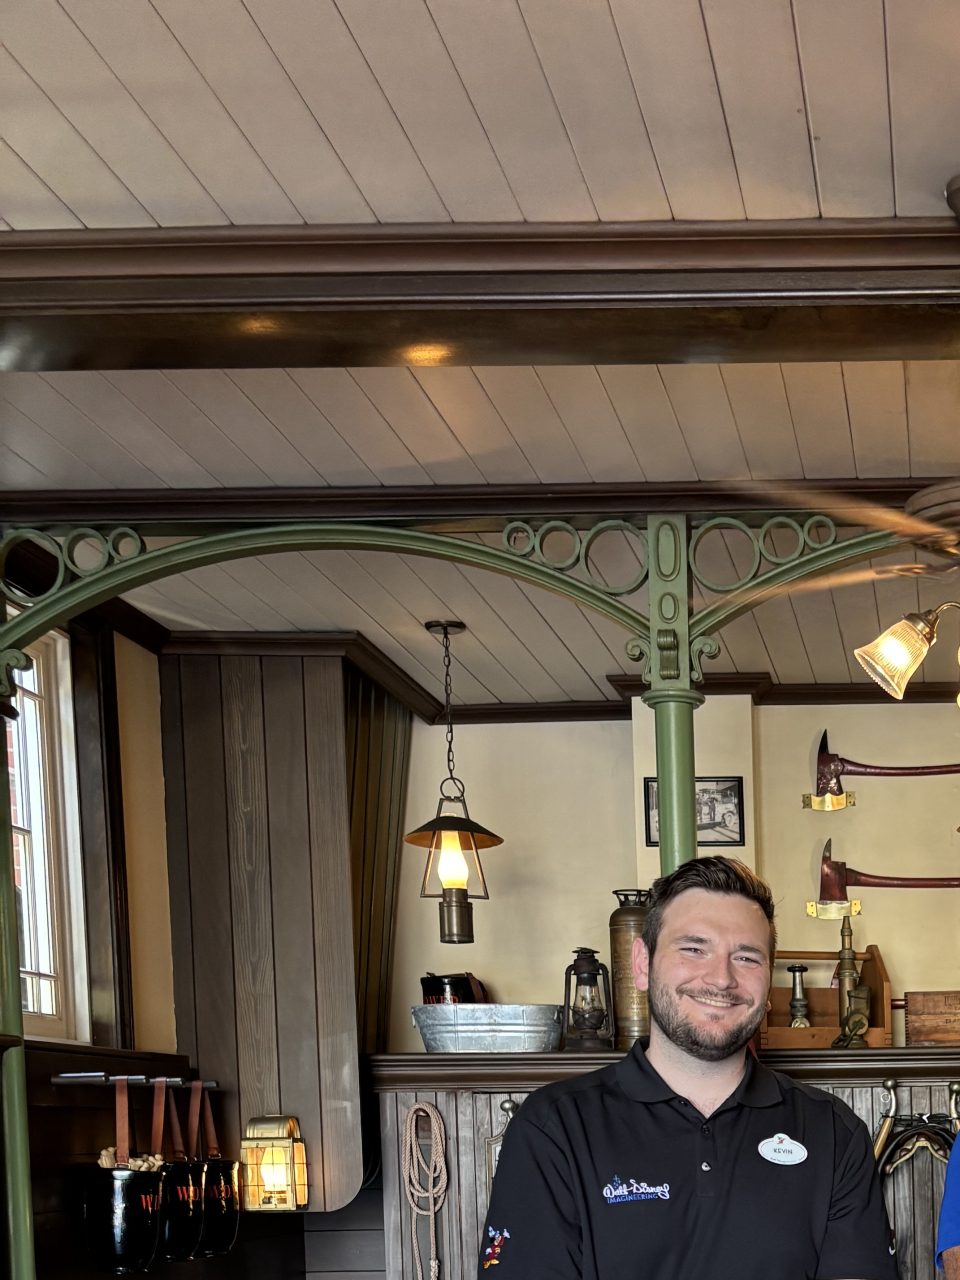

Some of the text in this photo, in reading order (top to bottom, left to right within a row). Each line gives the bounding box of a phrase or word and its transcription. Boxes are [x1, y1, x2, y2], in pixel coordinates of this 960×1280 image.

[603, 1178, 670, 1200] Walt Disney
[606, 1194, 659, 1204] IMAGINEERING
